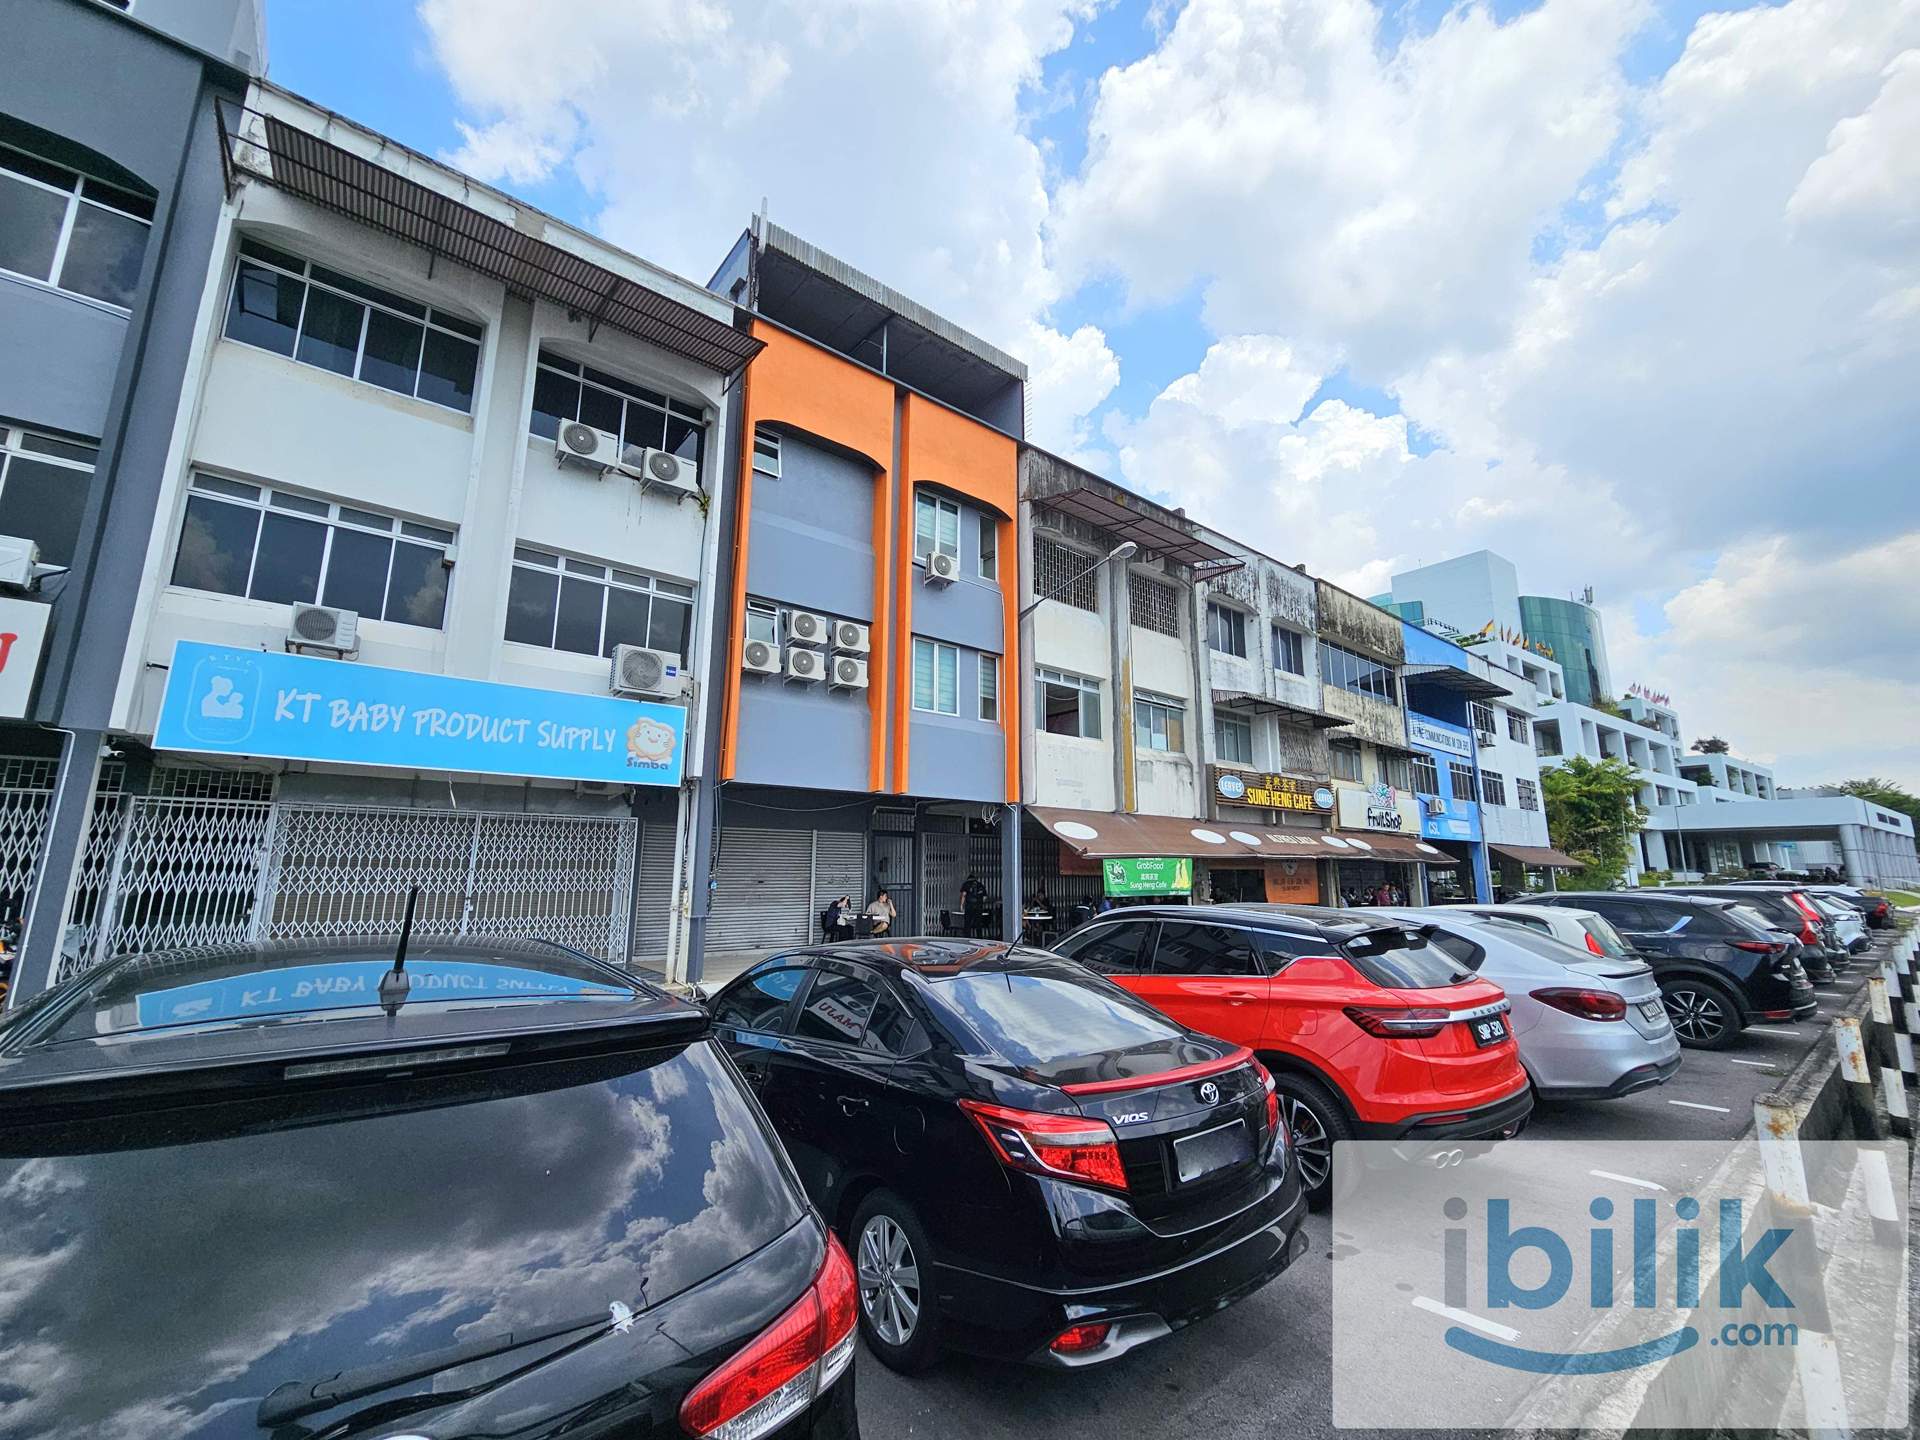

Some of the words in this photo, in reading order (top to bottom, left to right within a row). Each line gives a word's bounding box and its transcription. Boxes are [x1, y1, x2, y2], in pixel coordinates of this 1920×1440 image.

[274, 688, 322, 723] KT
[328, 698, 406, 732] BABY
[412, 708, 531, 744] PRODUCT
[537, 720, 616, 752] SUPPLY
[626, 757, 669, 770] Simba
[1247, 788, 1270, 806] SUNG
[1271, 790, 1292, 808] HENG
[1293, 793, 1313, 810] CAFE
[1136, 861, 1164, 870] GrabFood
[1130, 881, 1142, 890] Sung
[1112, 1112, 1149, 1125] VIOS
